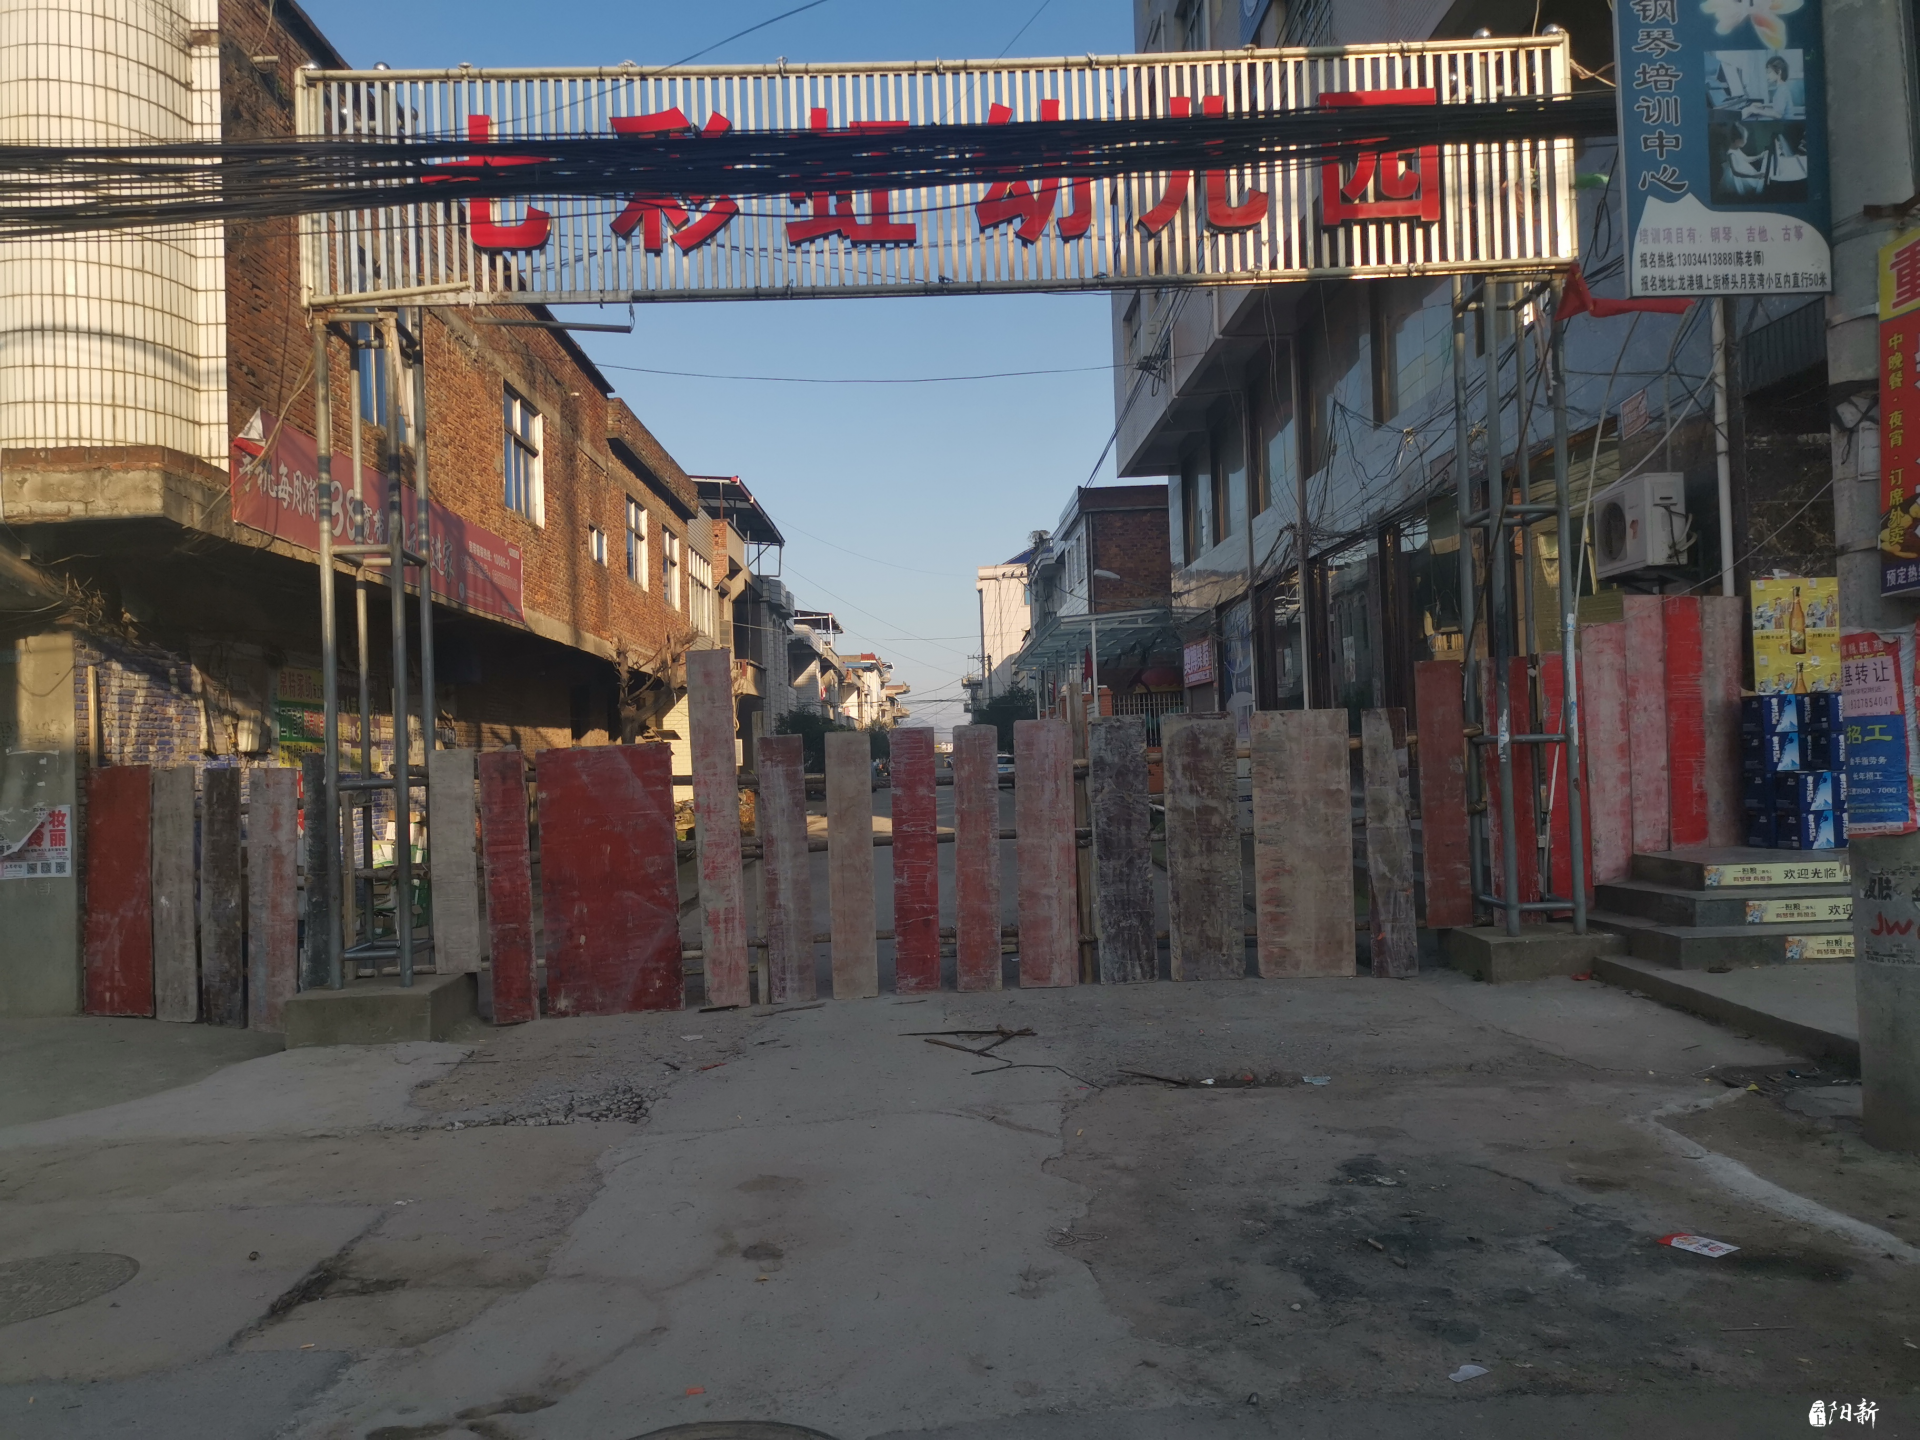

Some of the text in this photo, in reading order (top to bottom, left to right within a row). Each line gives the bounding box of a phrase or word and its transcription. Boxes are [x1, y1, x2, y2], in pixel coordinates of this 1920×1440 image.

[1631, 0, 1688, 194] 钢琴培训中心
[1886, 562, 1920, 588] 预定热
[1783, 867, 1837, 880] 欢迎光临
